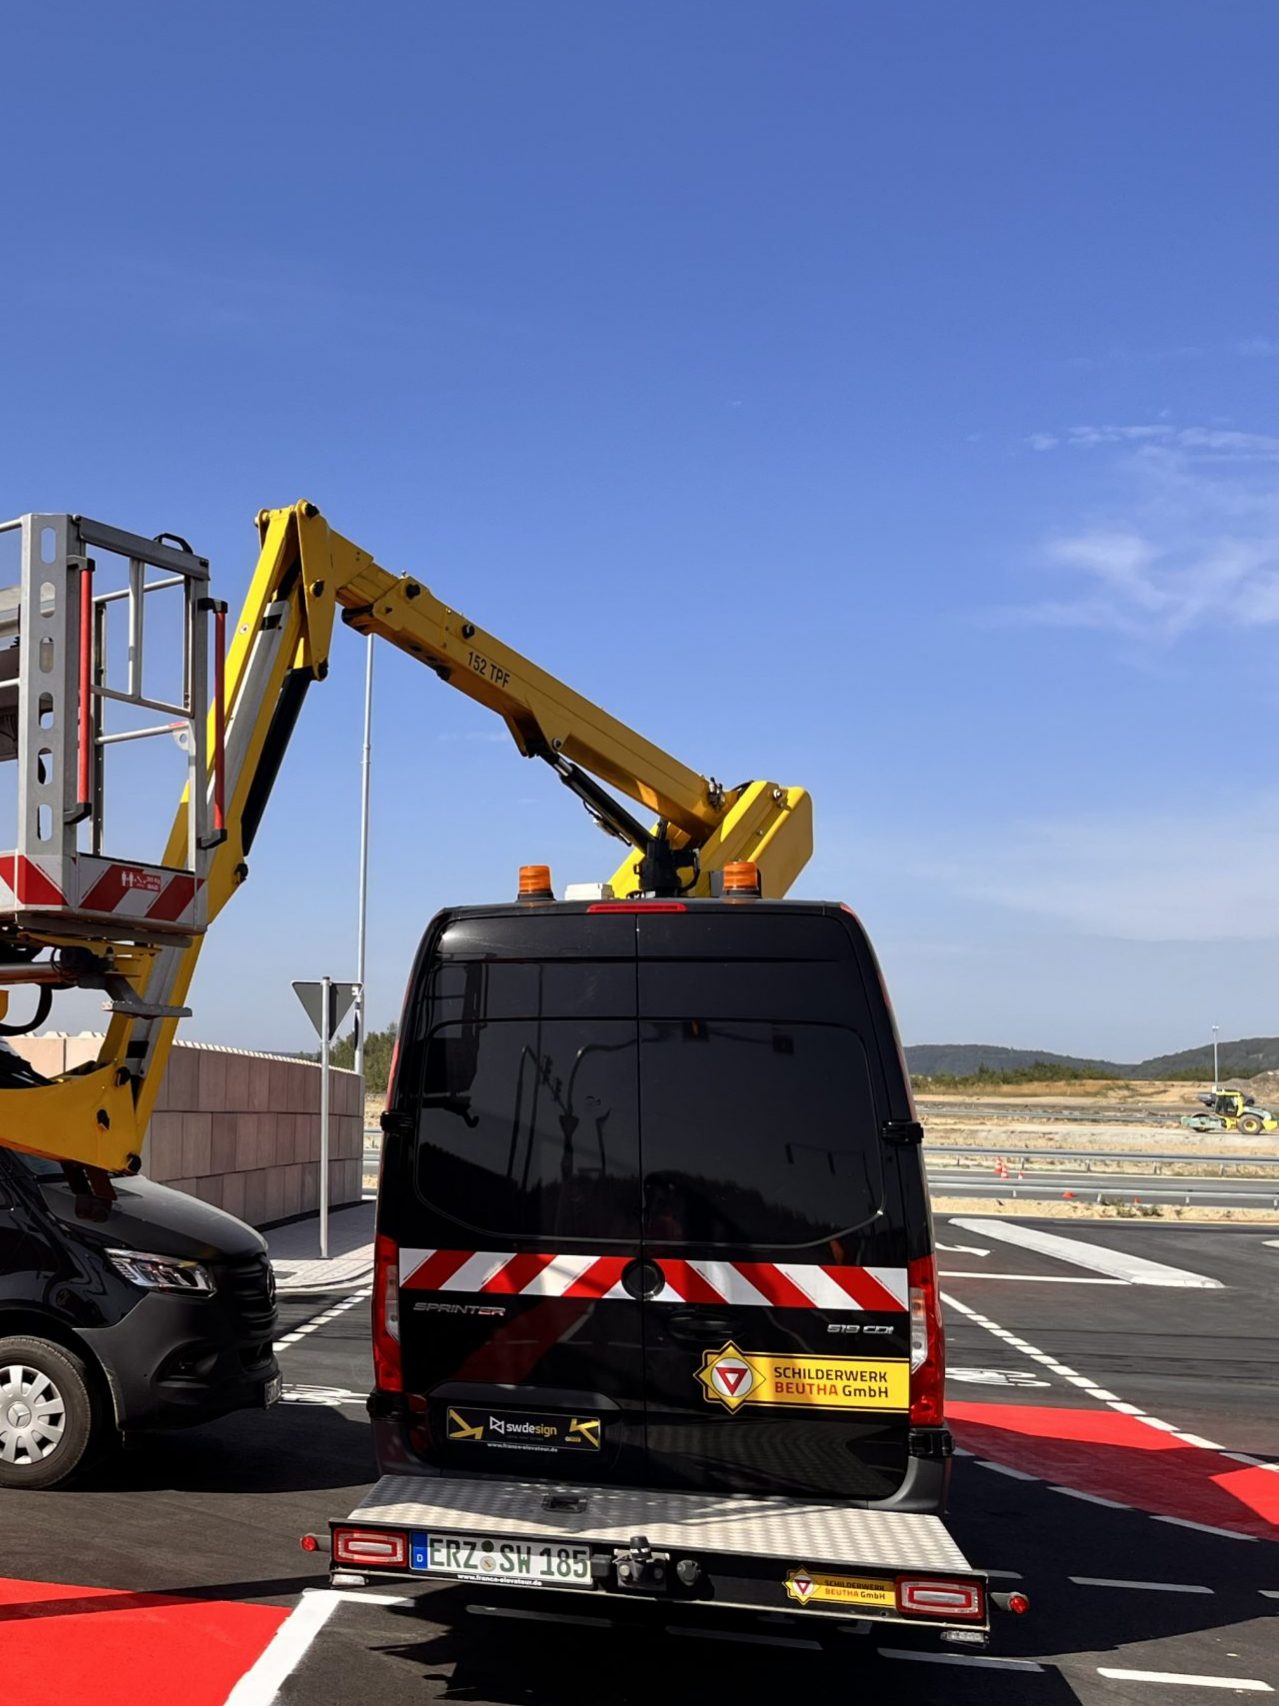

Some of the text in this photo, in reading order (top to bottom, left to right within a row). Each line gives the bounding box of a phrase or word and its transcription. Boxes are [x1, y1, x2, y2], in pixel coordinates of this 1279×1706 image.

[468, 651, 510, 688] 152 TPF
[413, 1302, 506, 1317] SPRINTER
[827, 1324, 860, 1334] 519
[774, 1366, 888, 1383] SCHILDERWERK
[775, 1381, 889, 1398] BEUTHA GmbH
[506, 1422, 558, 1437] swdesign
[430, 1538, 479, 1570] ERZ
[499, 1543, 532, 1575] SW
[540, 1547, 589, 1579] 185
[860, 1591, 886, 1600] GmbH
